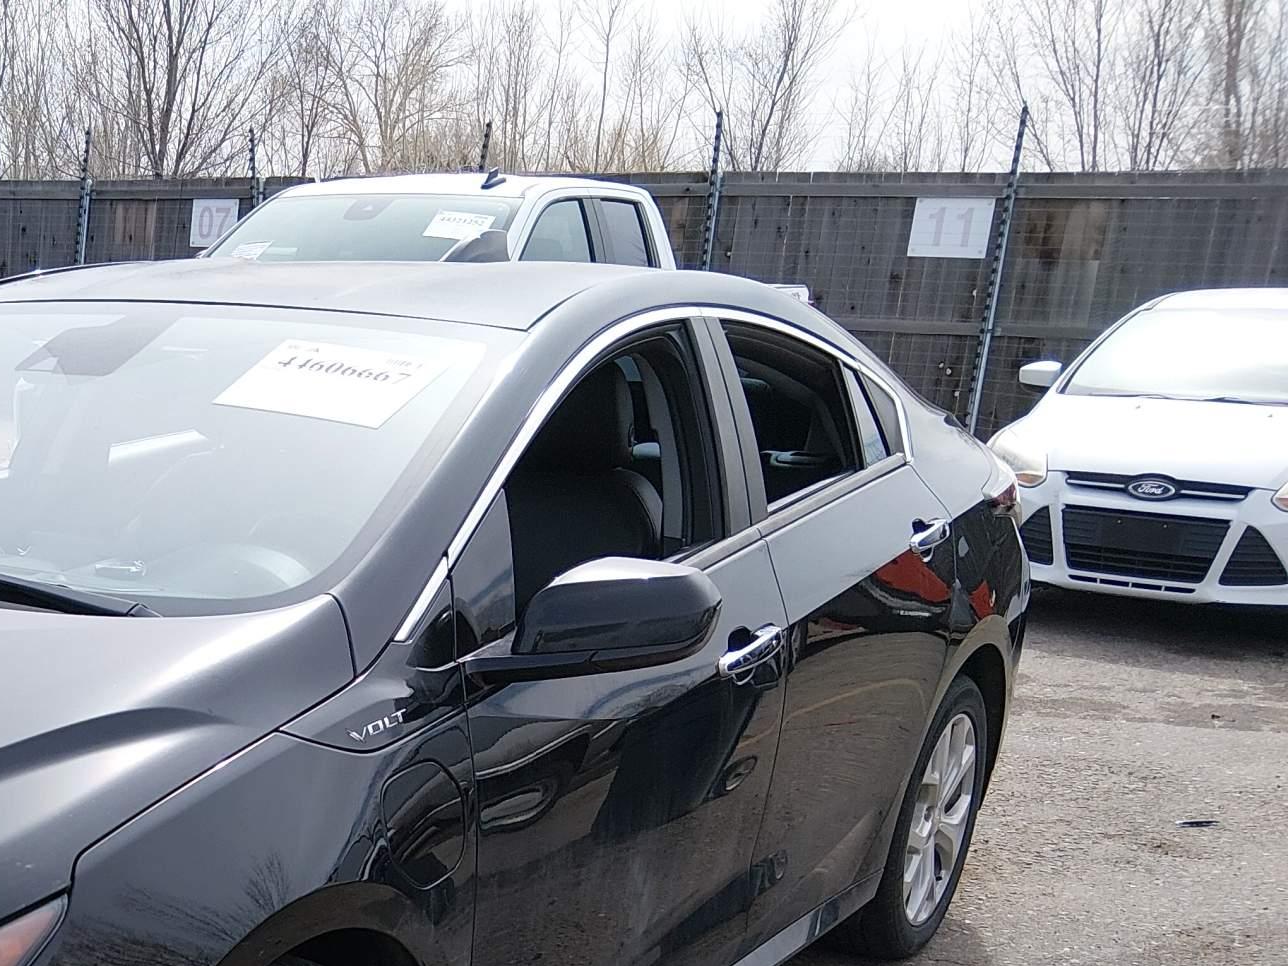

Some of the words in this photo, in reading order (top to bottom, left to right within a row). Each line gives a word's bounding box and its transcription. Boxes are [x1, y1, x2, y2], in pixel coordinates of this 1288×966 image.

[198, 206, 232, 240] 07
[928, 206, 975, 248] 11
[277, 355, 413, 385] 44606667
[345, 707, 407, 742] VOLT
